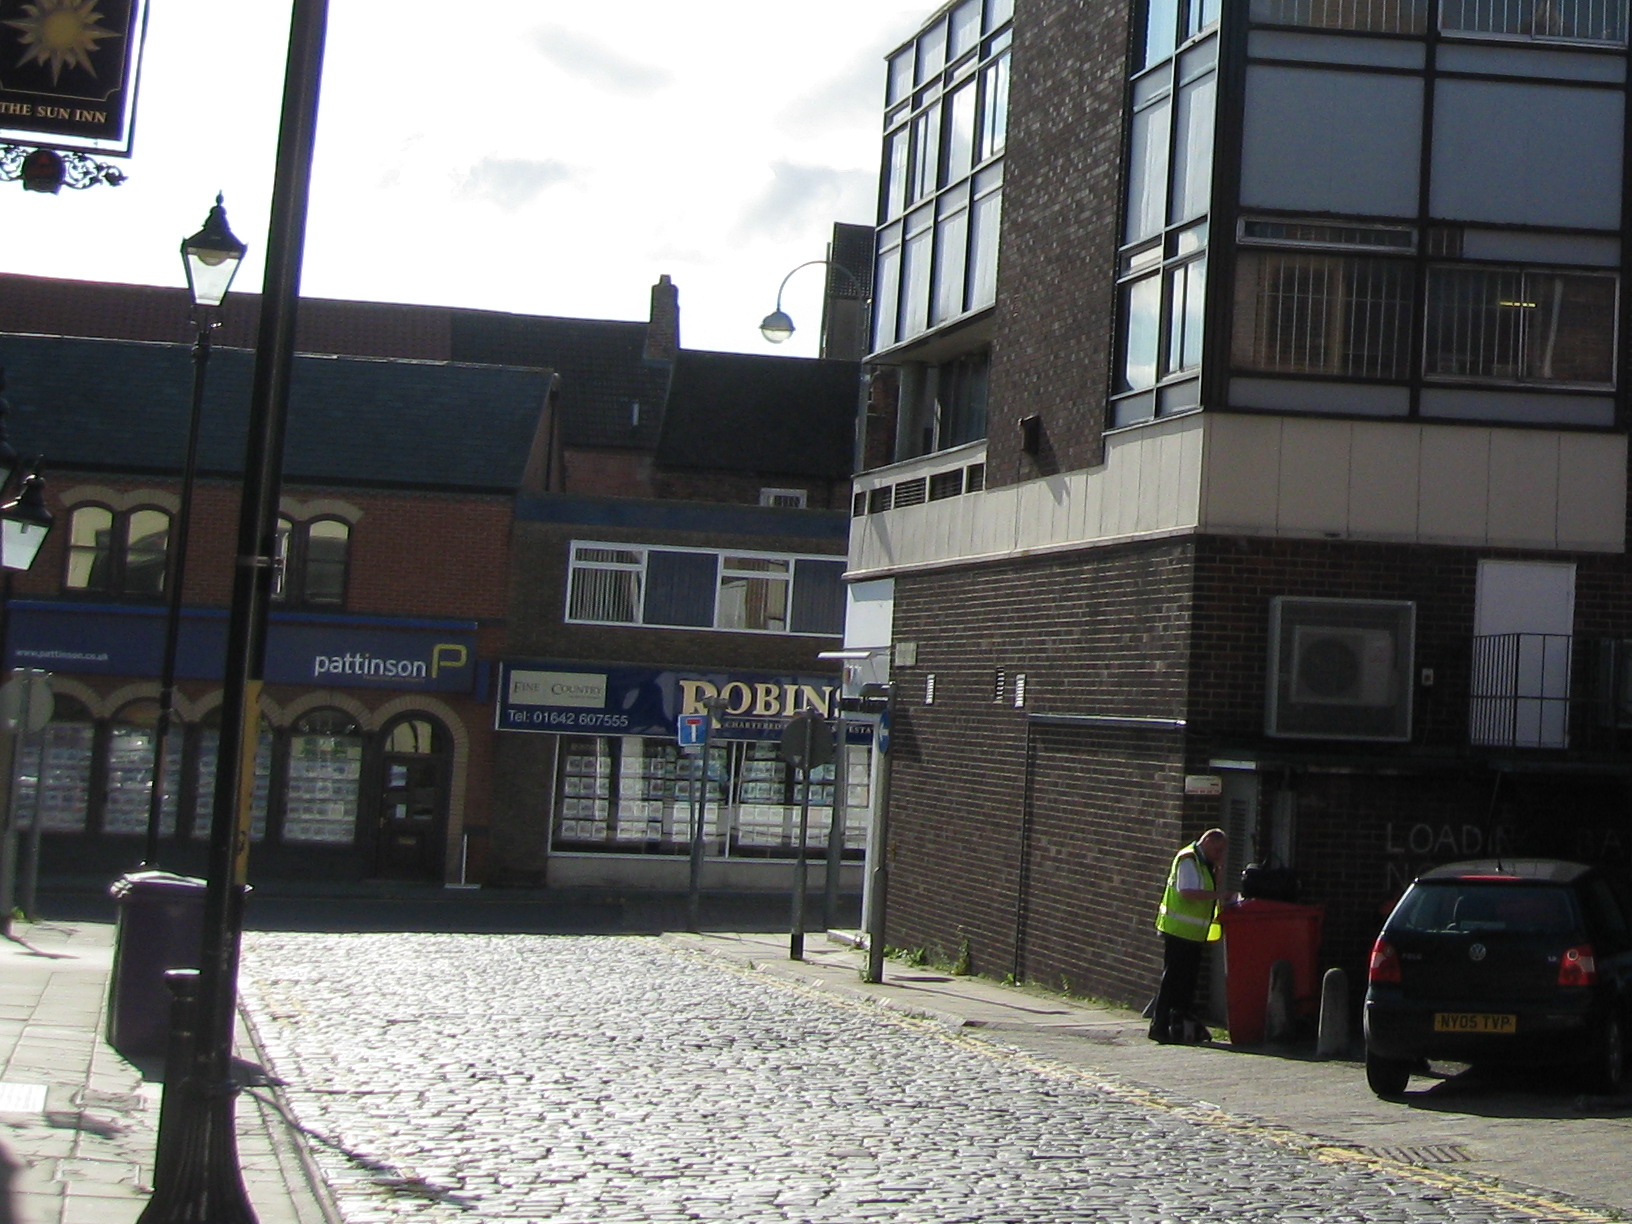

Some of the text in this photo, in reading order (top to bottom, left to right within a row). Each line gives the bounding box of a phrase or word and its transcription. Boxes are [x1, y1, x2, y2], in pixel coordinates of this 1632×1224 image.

[0, 102, 108, 124] THE SUN INN
[314, 652, 427, 679] pattinson
[508, 709, 629, 728] Tel: 01642 607555
[1440, 1014, 1511, 1031] NY05 TVP
